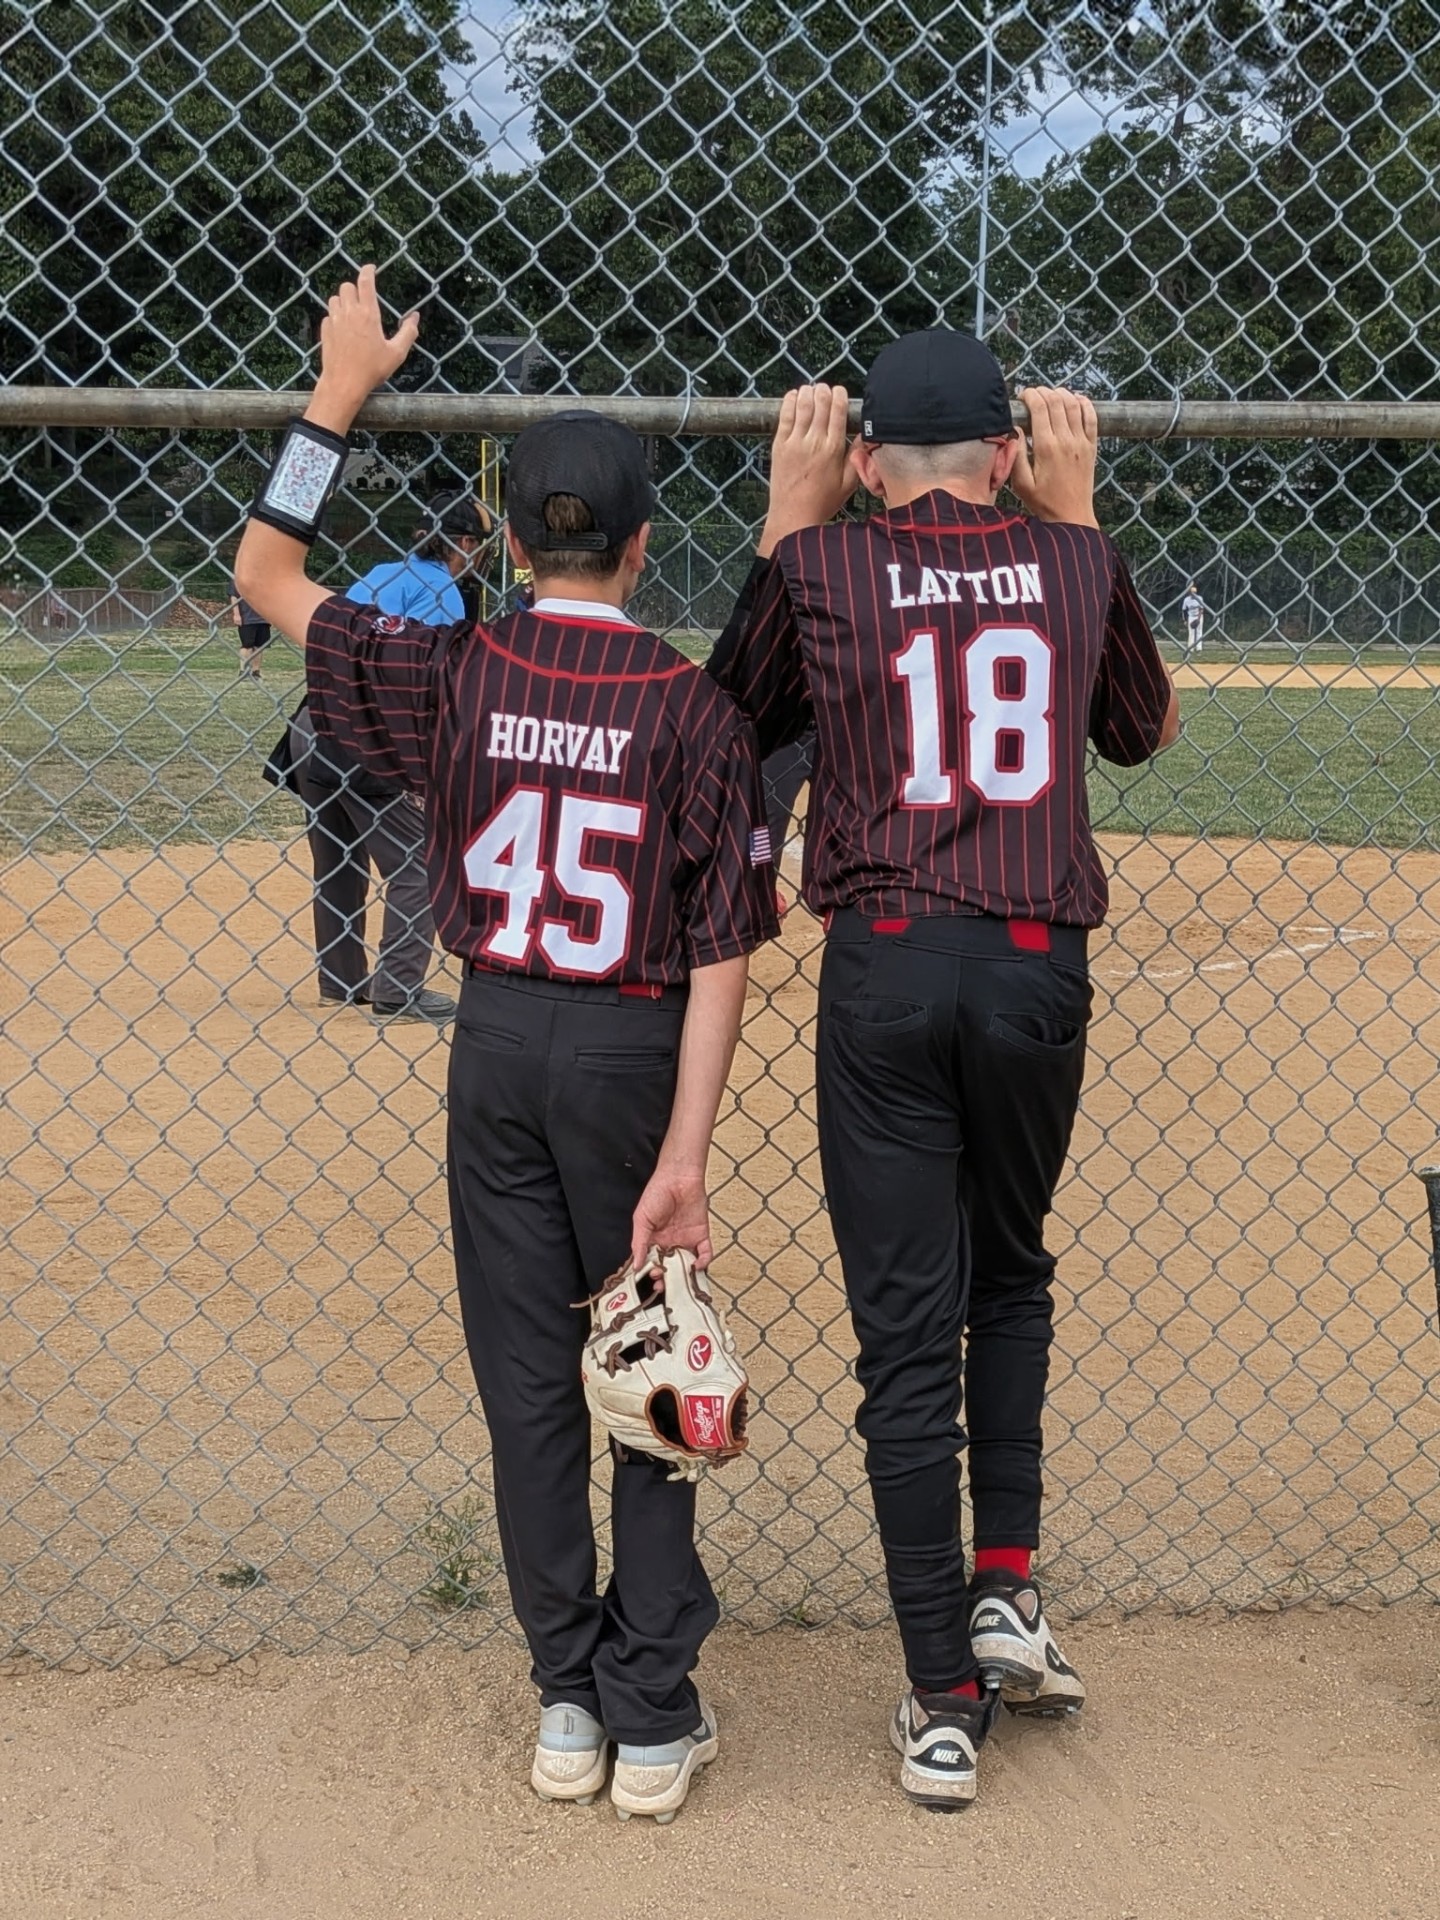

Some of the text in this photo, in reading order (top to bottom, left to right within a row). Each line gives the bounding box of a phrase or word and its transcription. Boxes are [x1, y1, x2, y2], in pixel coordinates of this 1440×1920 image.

[886, 563, 1044, 608] LAYTON
[890, 623, 1056, 810] 18
[486, 712, 632, 775] HORVAY
[463, 784, 648, 980] 45
[693, 1400, 714, 1443] Rawlings
[975, 1614, 1003, 1629] NIKE
[931, 1748, 961, 1764] NIKE
